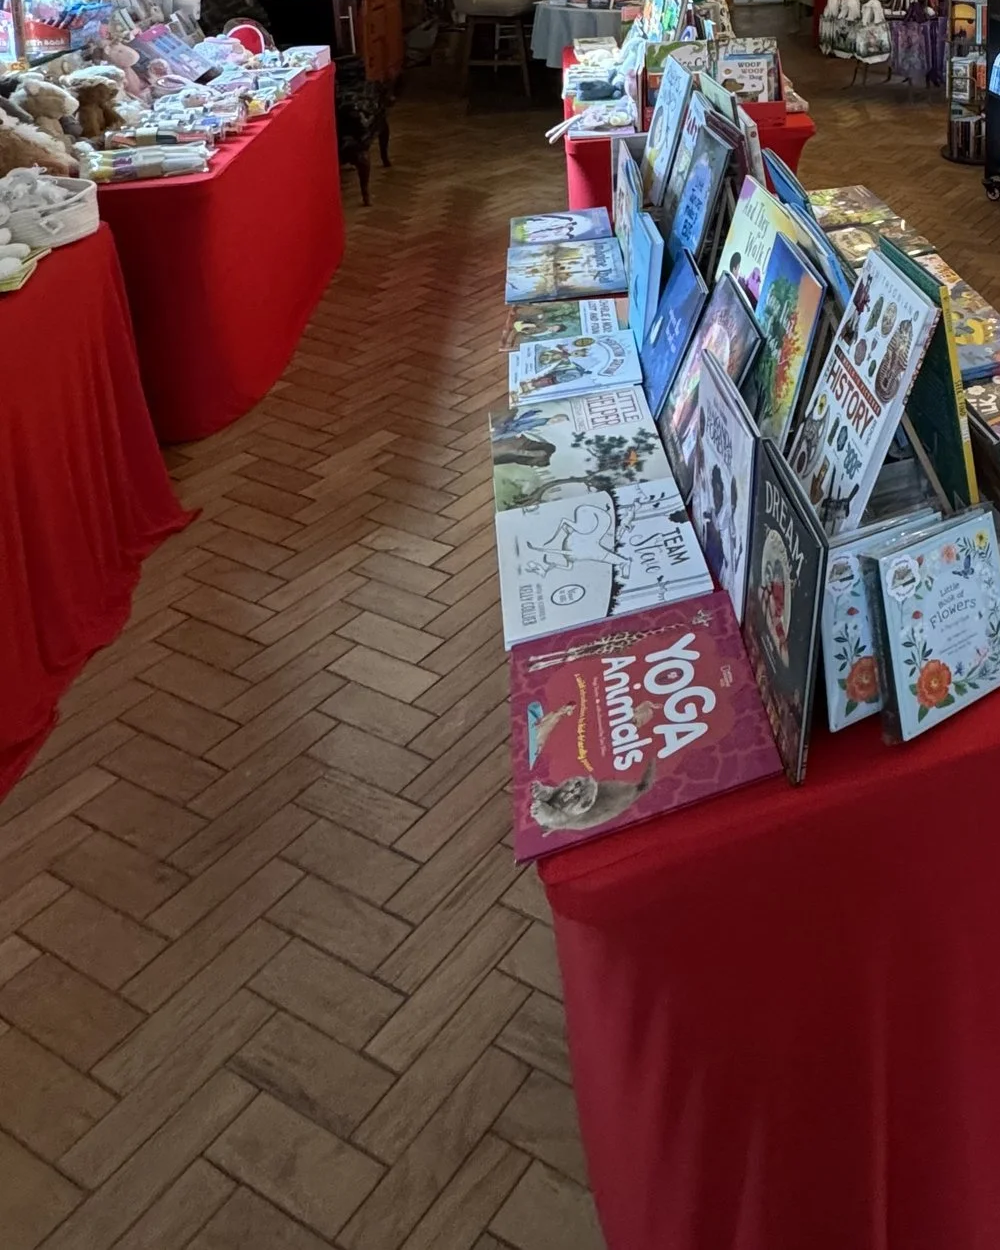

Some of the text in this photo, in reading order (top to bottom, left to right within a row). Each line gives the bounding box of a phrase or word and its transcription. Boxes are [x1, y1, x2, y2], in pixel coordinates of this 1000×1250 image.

[743, 199, 770, 239] And They
[745, 231, 765, 265] Walk
[587, 393, 621, 429] HELPER
[616, 390, 640, 423] LITTLE
[826, 360, 874, 440] HISTORY
[662, 527, 691, 566] TEAM
[765, 480, 805, 580] DREAM
[629, 532, 664, 574] Steve
[938, 589, 964, 609] Book of
[940, 583, 960, 597] Little
[929, 598, 976, 630] Flowers
[600, 655, 653, 771] Animals
[643, 632, 717, 759] YOGA
